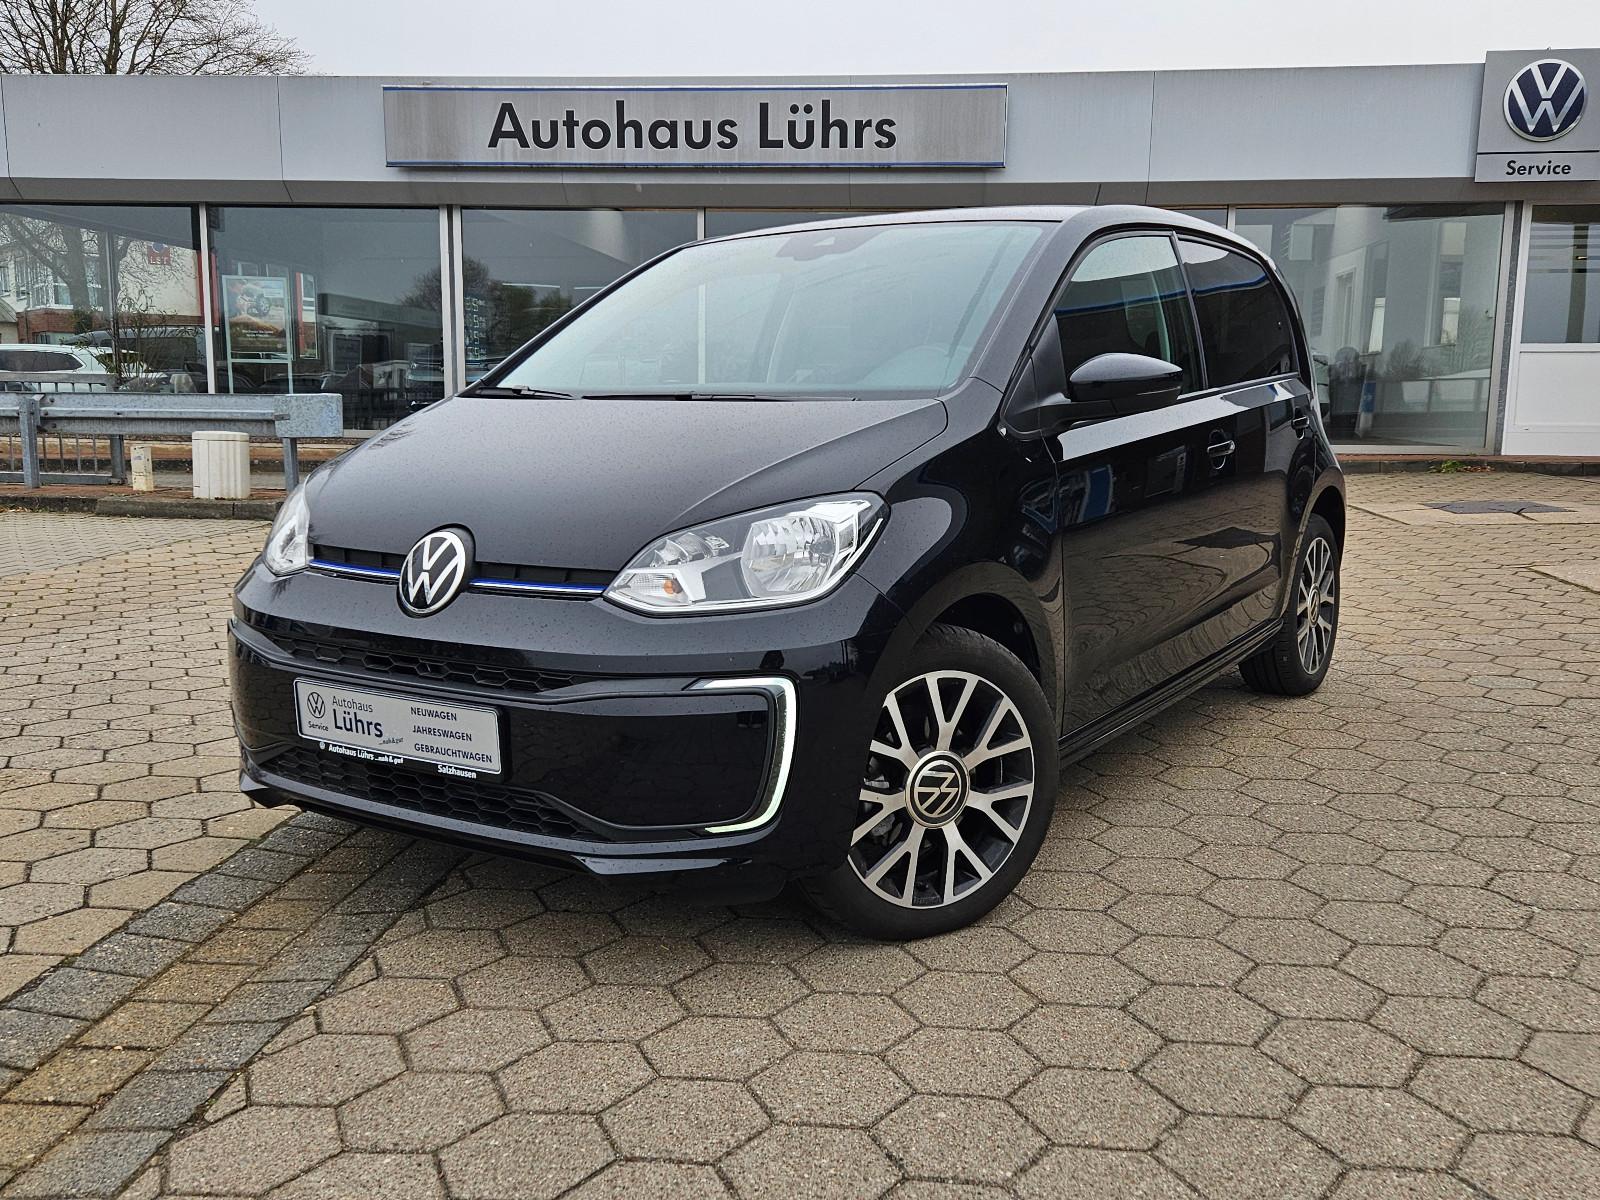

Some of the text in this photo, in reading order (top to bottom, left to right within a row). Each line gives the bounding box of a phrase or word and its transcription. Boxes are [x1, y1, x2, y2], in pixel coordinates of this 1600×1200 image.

[488, 99, 897, 149] Autohaus Lührs
[1506, 160, 1571, 175] Service
[332, 696, 373, 713] Autohaus
[410, 706, 457, 721] NEUWAGEN
[308, 721, 329, 732] Service
[333, 709, 383, 738] Lührs
[412, 725, 472, 742] JAHRESWAGEN
[328, 744, 357, 757] Autohaus
[357, 750, 375, 761] Lührs
[414, 743, 492, 764] GEBRAUCHTWAGEN
[437, 764, 477, 779] Salzhausen
